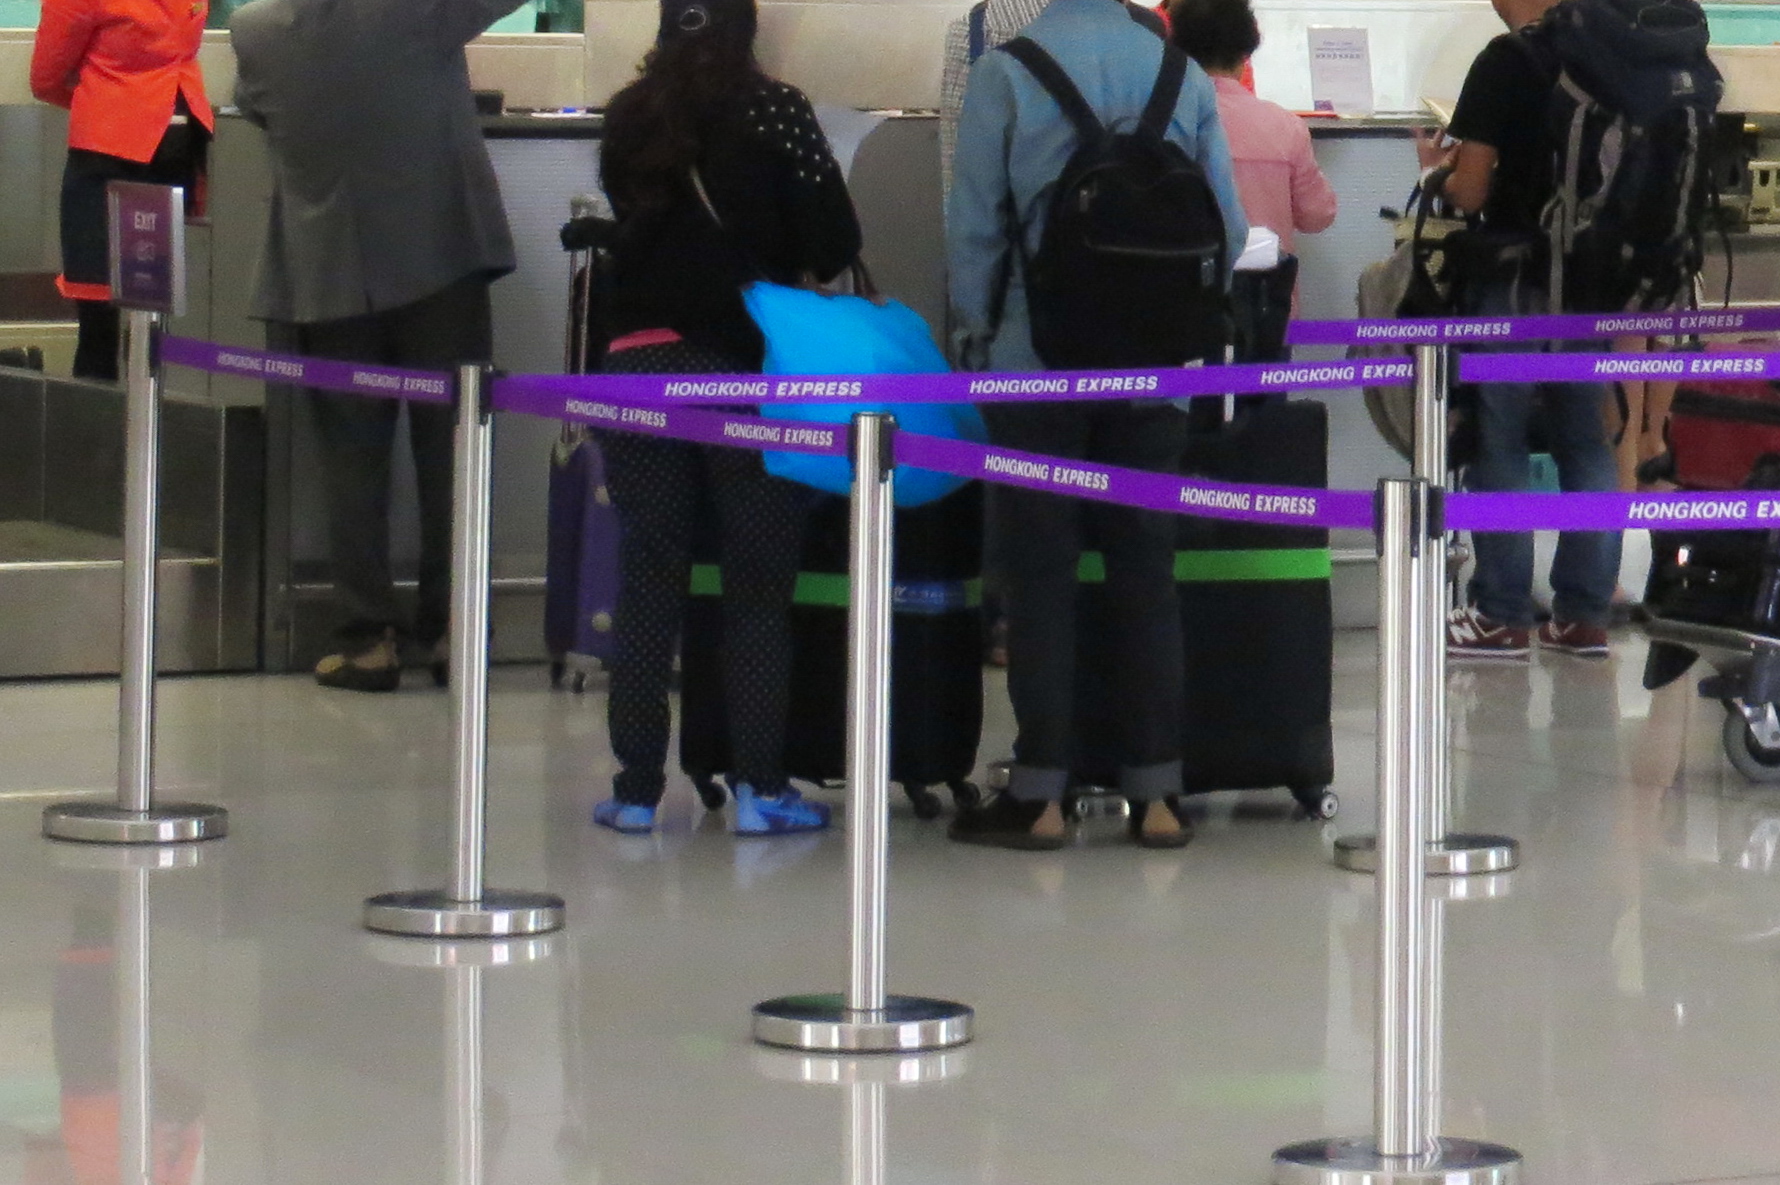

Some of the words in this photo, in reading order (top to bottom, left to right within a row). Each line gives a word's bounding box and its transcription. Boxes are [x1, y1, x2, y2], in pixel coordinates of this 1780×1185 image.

[134, 211, 157, 231] EXIT
[1356, 325, 1437, 338] HONGKONG
[1444, 322, 1511, 336] EXPRESS
[1595, 317, 1673, 332] HONGKONG
[1679, 315, 1744, 330] EXPRESS
[1261, 366, 1355, 385] HONGKONG
[1594, 359, 1684, 374] HONGKONG
[1690, 358, 1765, 373] EXPRESS
[353, 371, 400, 390] HONGKONG
[404, 377, 444, 394] EXPRESS
[664, 382, 769, 396] HONGKONG
[776, 382, 862, 396] EXPRESS
[969, 379, 1068, 394] HONGKONG
[1076, 376, 1158, 392] EXPRESS
[565, 399, 618, 421] HONGKONG
[621, 408, 667, 428] EXPRESS
[724, 422, 780, 443] HONGKONG
[784, 428, 834, 446] EXPRESS
[984, 454, 1049, 480] HONGKONG
[1053, 467, 1109, 490] EXPRESS
[1180, 487, 1250, 511] HONGKONG
[1255, 494, 1316, 515] EXPRESS
[1628, 500, 1747, 521] HONGKONG
